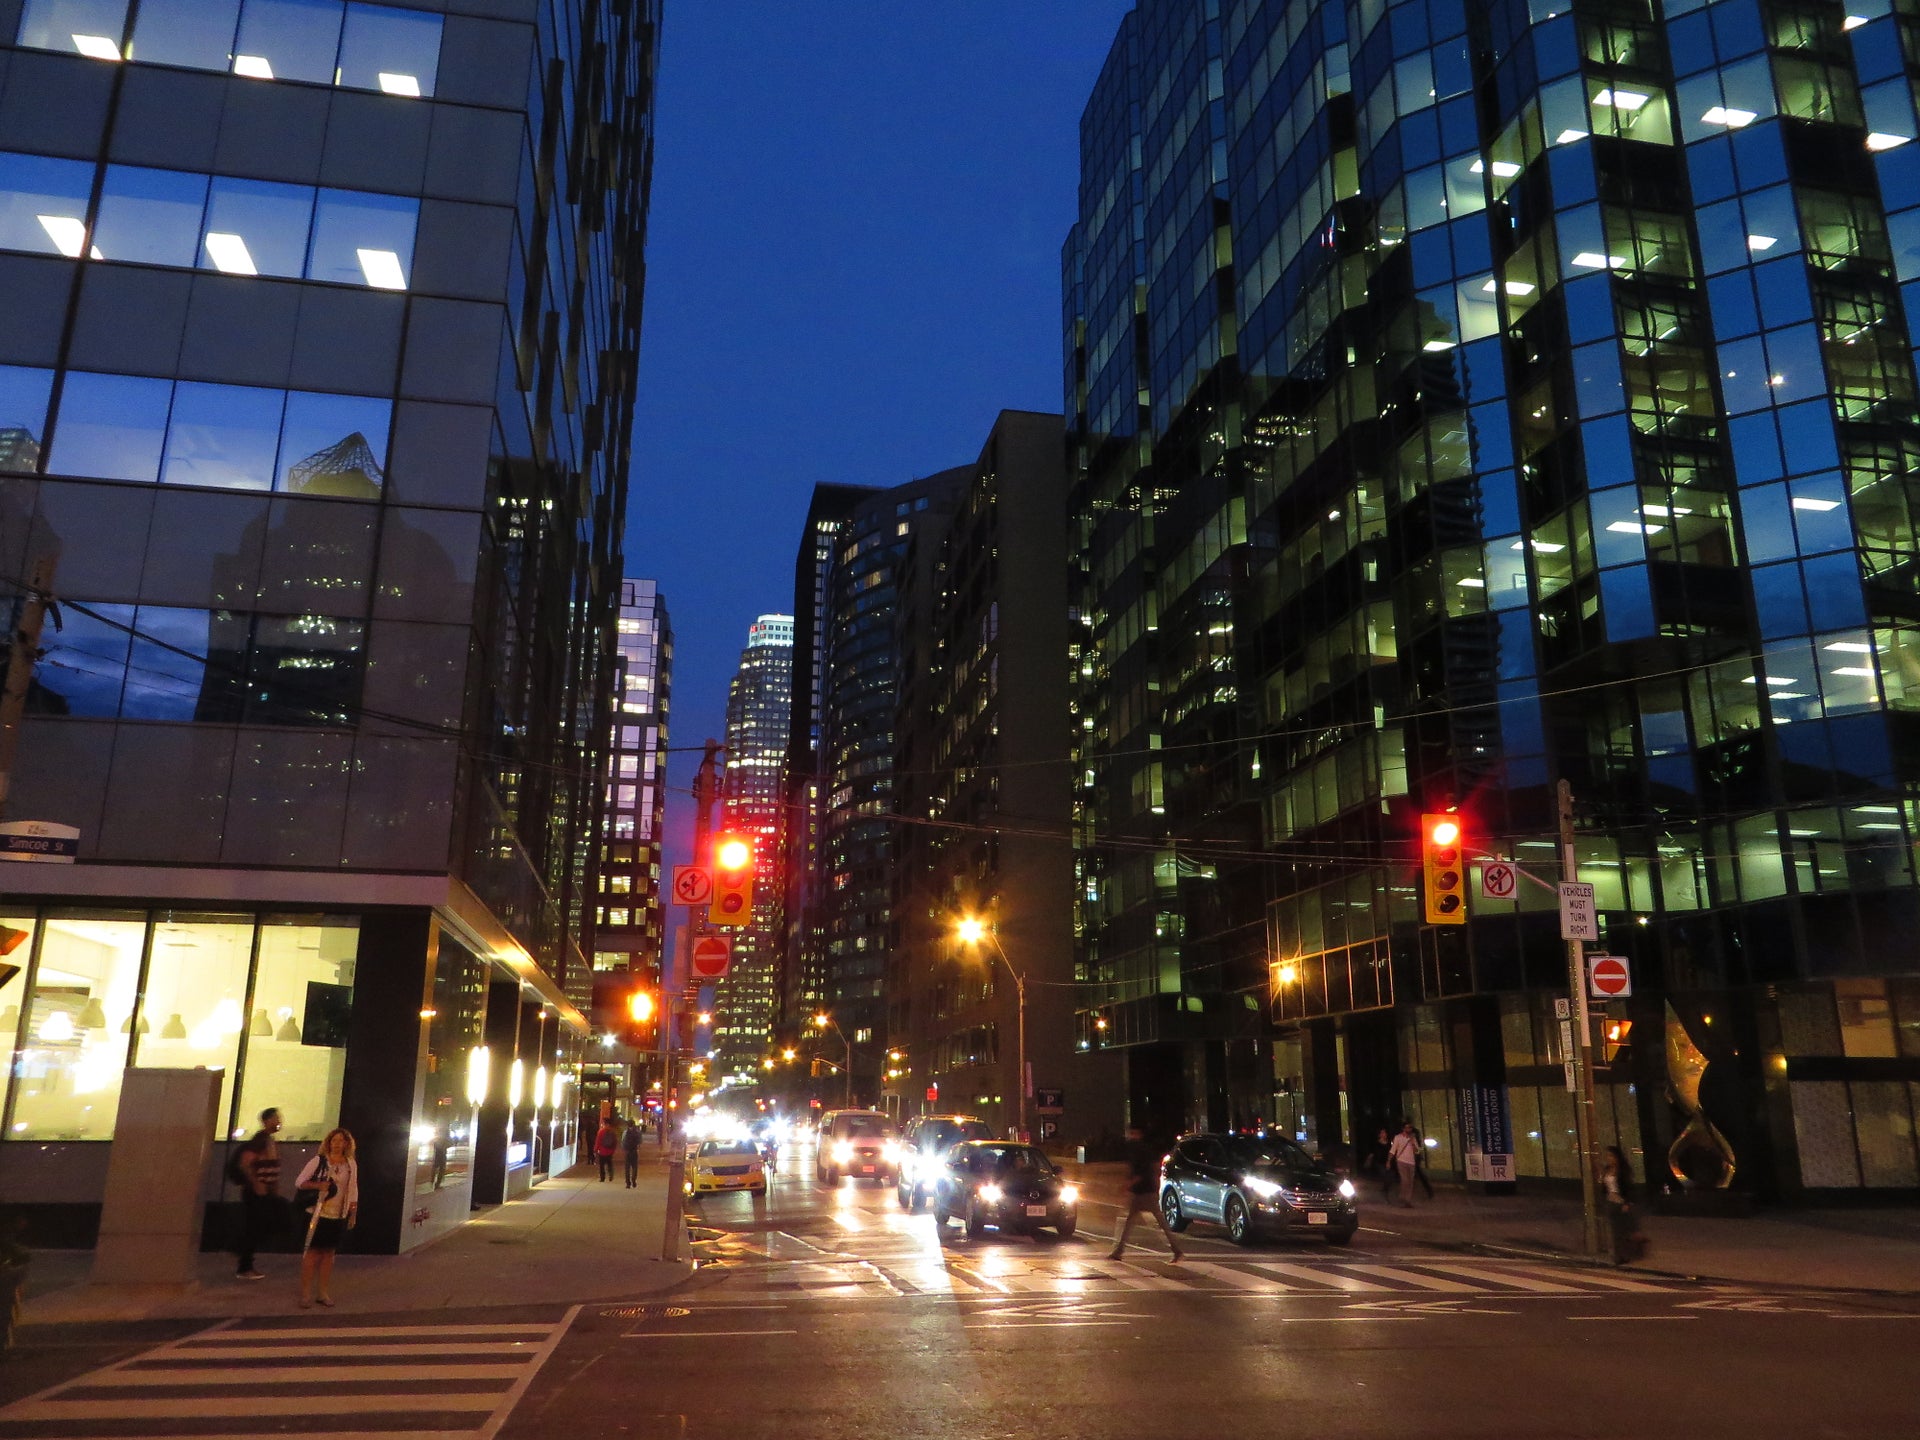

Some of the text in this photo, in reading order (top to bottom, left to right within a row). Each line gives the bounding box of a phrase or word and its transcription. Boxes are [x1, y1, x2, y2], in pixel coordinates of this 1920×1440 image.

[8, 837, 49, 851] Simcoe
[1562, 887, 1592, 897] VEHICLES
[1569, 900, 1586, 910] MUST
[1570, 912, 1587, 923] TURN
[1570, 925, 1588, 935] RIGHT
[1047, 1094, 1055, 1105] P
[1045, 1122, 1056, 1137] P
